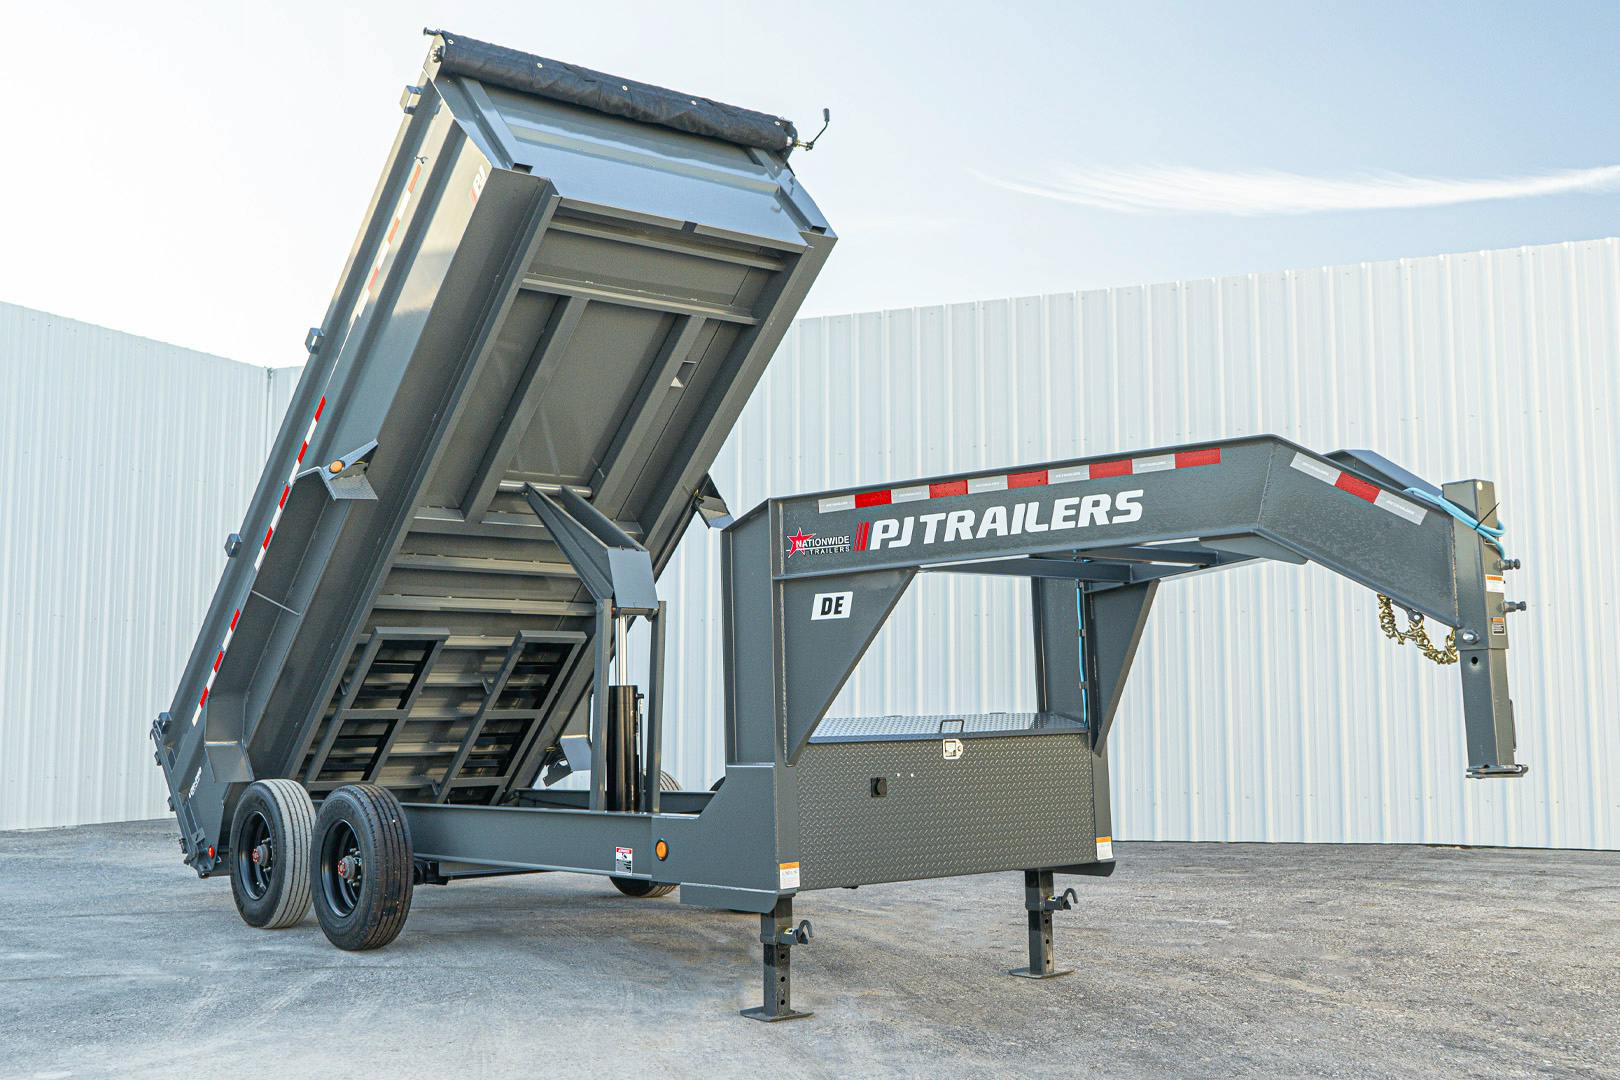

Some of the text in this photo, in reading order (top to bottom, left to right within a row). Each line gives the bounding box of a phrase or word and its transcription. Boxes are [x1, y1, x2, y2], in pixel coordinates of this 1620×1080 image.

[796, 536, 850, 548] NATIONWIDE
[810, 546, 850, 555] TRAILERS
[821, 596, 845, 616] DE
